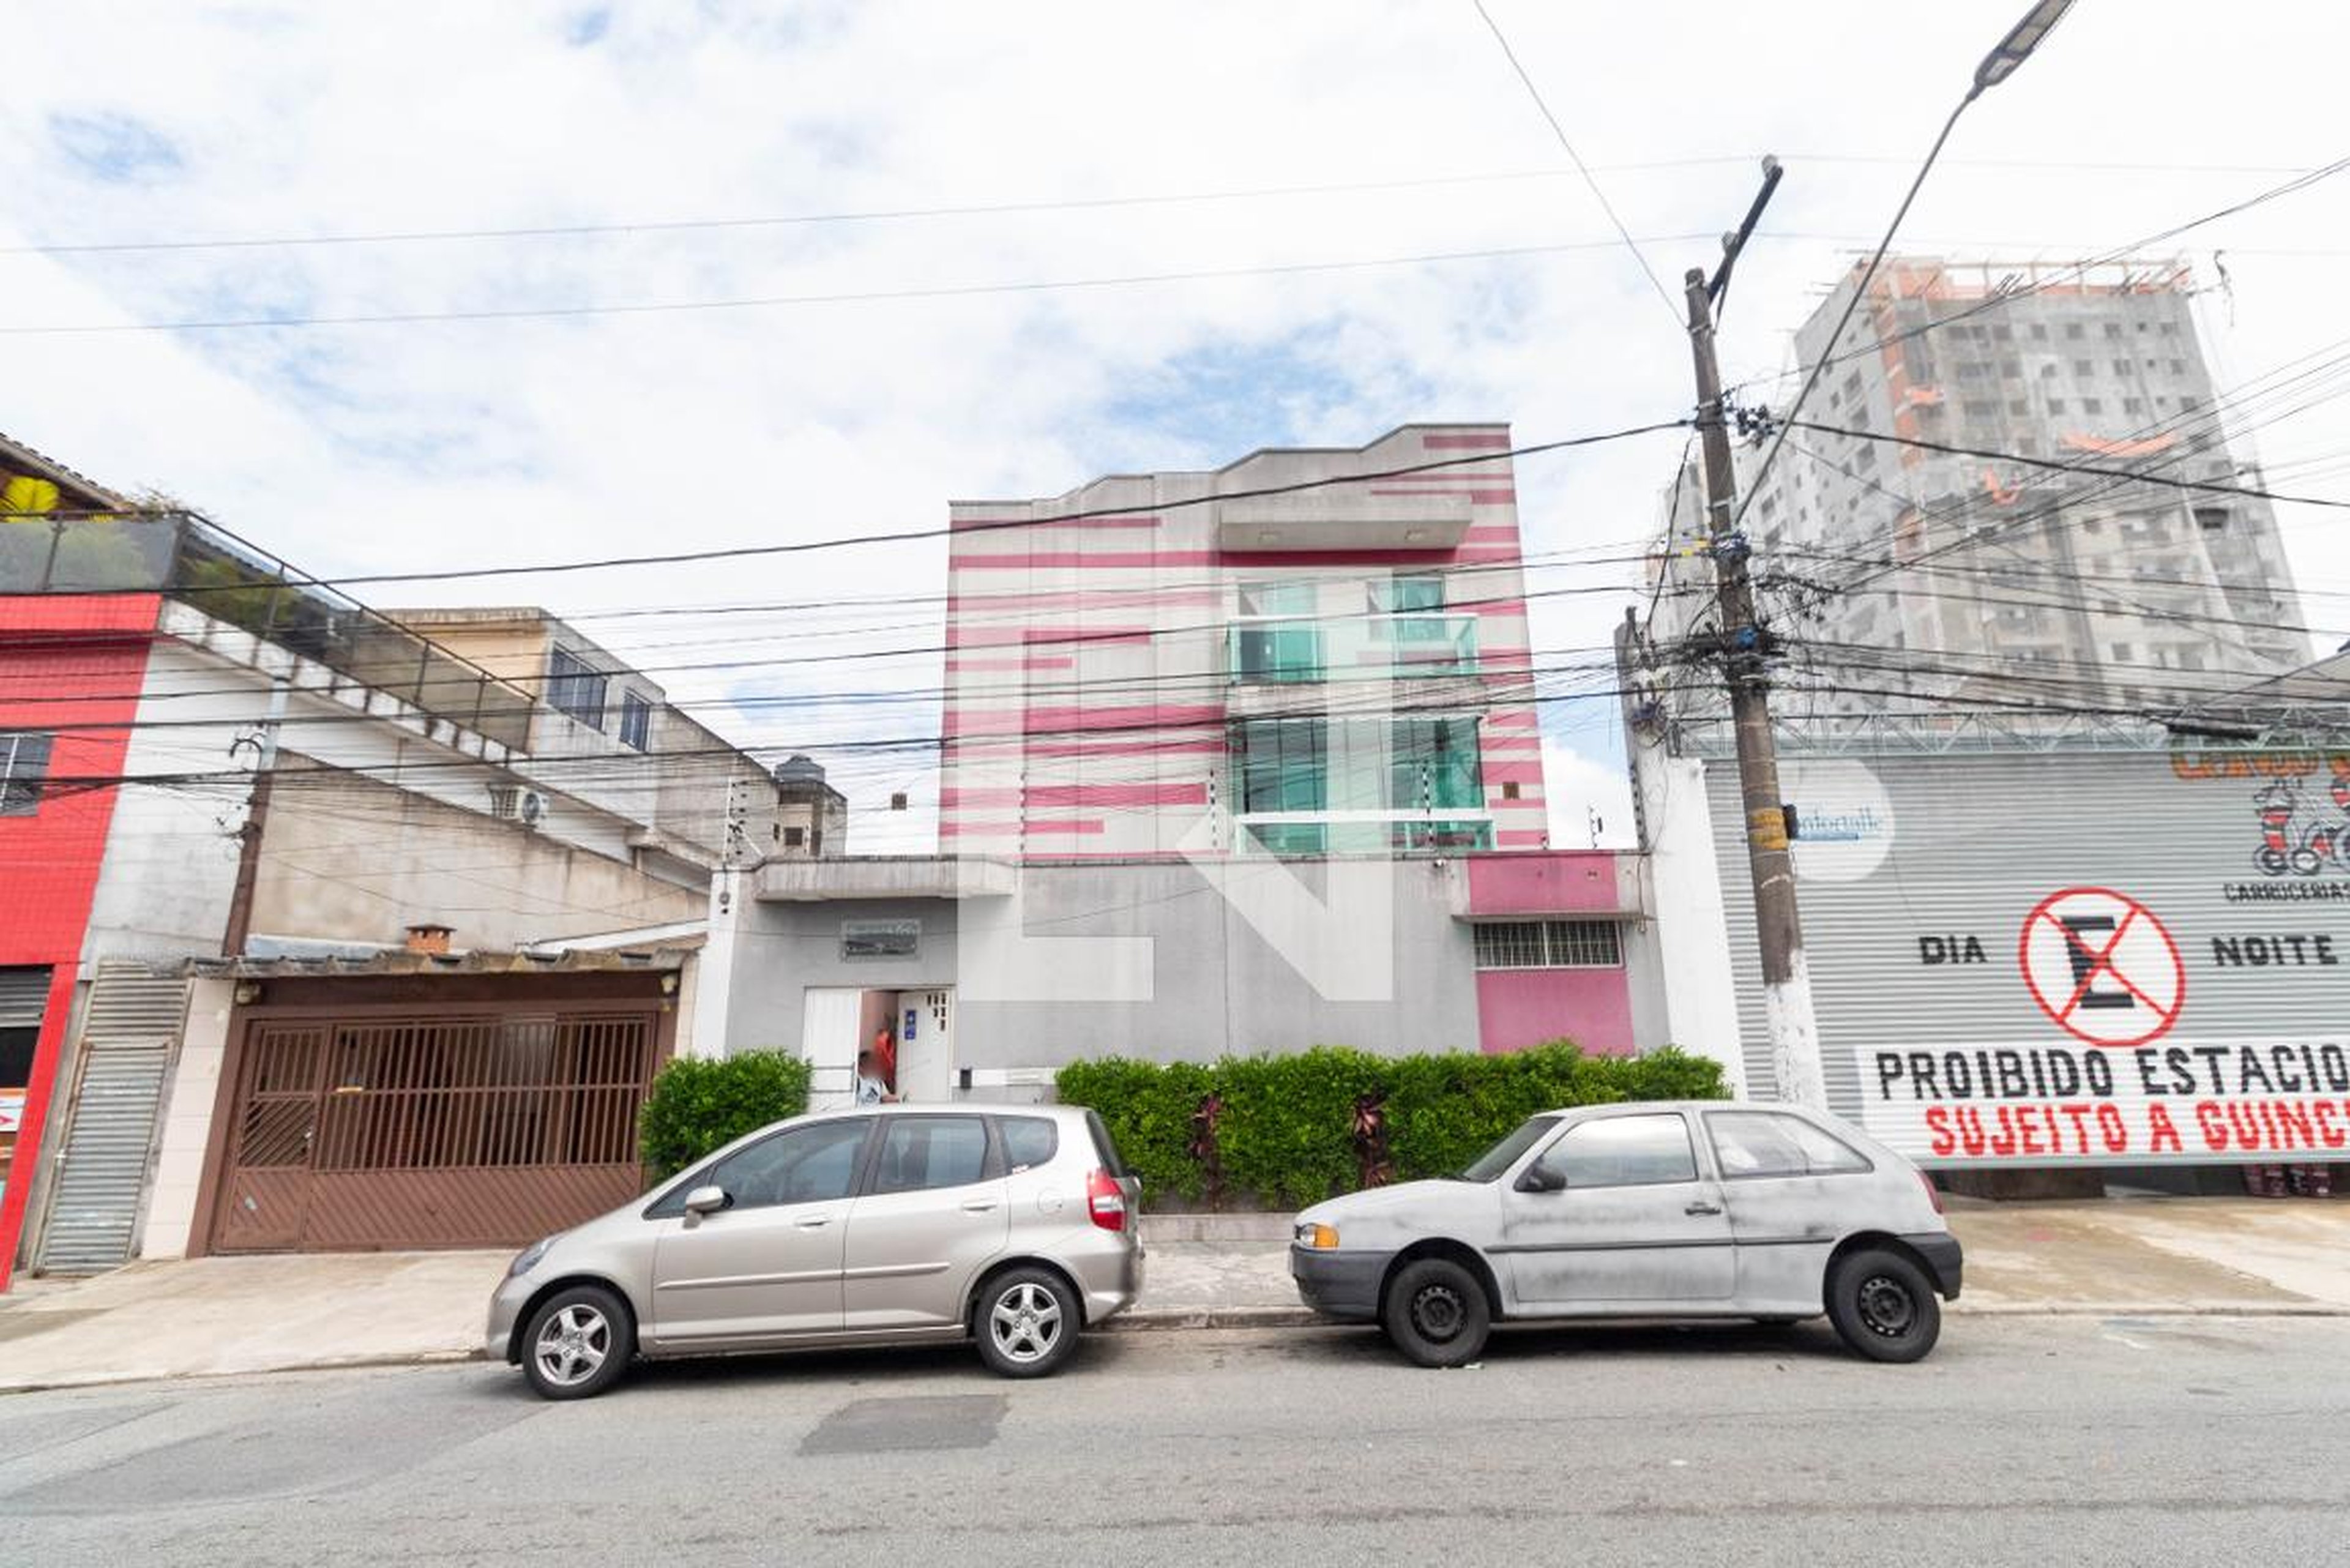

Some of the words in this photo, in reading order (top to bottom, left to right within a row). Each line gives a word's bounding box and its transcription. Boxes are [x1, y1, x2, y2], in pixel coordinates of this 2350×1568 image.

[1919, 935, 1988, 965] DIA
[2060, 916, 2135, 1009] E
[2212, 935, 2338, 966] NOITE
[1876, 1048, 2113, 1100] PROIBIDO
[1925, 1103, 2127, 1155] SUJEITO
[2148, 1102, 2184, 1152] A
